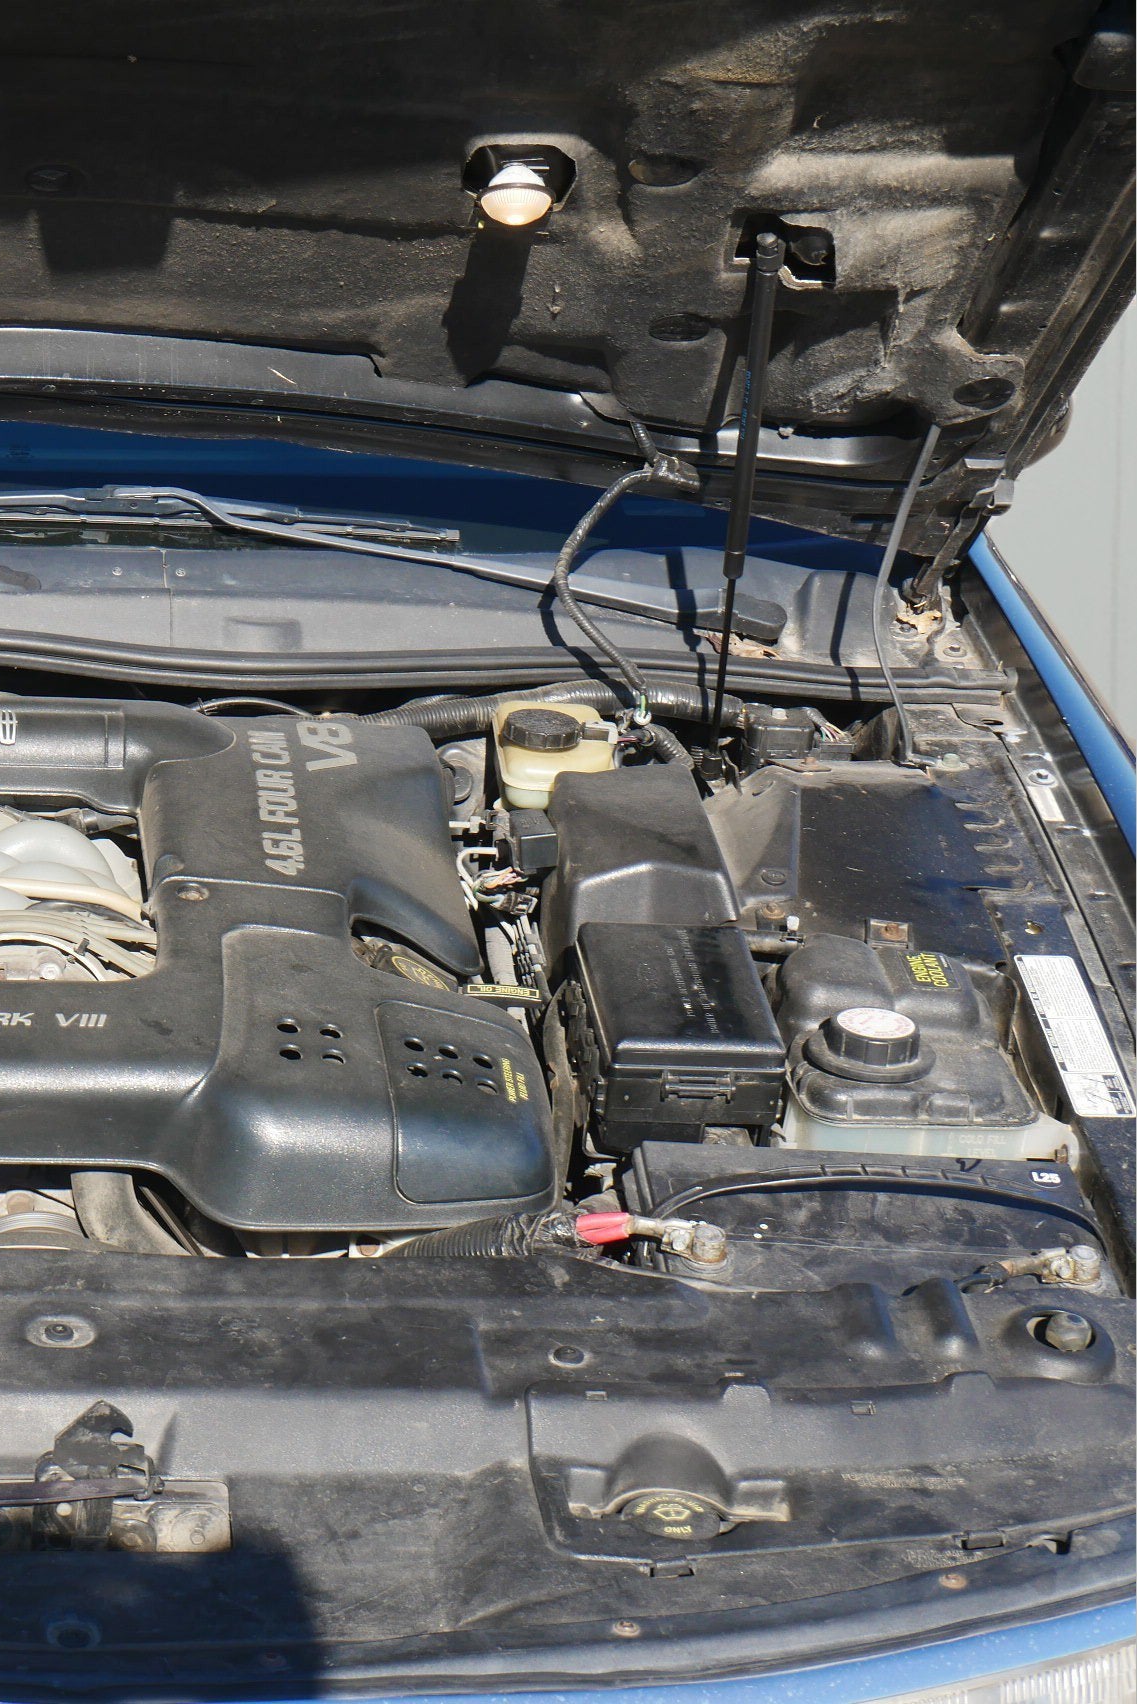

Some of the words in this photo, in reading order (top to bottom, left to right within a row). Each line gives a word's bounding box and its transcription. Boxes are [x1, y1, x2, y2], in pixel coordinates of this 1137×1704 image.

[247, 730, 291, 765] CAM
[296, 721, 358, 772] V8
[255, 769, 300, 825] FOUR
[261, 828, 305, 876] 4.6L
[906, 955, 932, 983] ENGINE
[920, 952, 950, 988] COOLANT
[495, 986, 530, 997] ENGINE
[55, 1012, 108, 1028] VIII
[959, 1134, 983, 1144] COLD
[985, 1135, 1006, 1145] FILL
[967, 1148, 994, 1157] LEVEL
[1030, 1171, 1061, 1184] L25
[664, 1525, 692, 1535] ONLY
